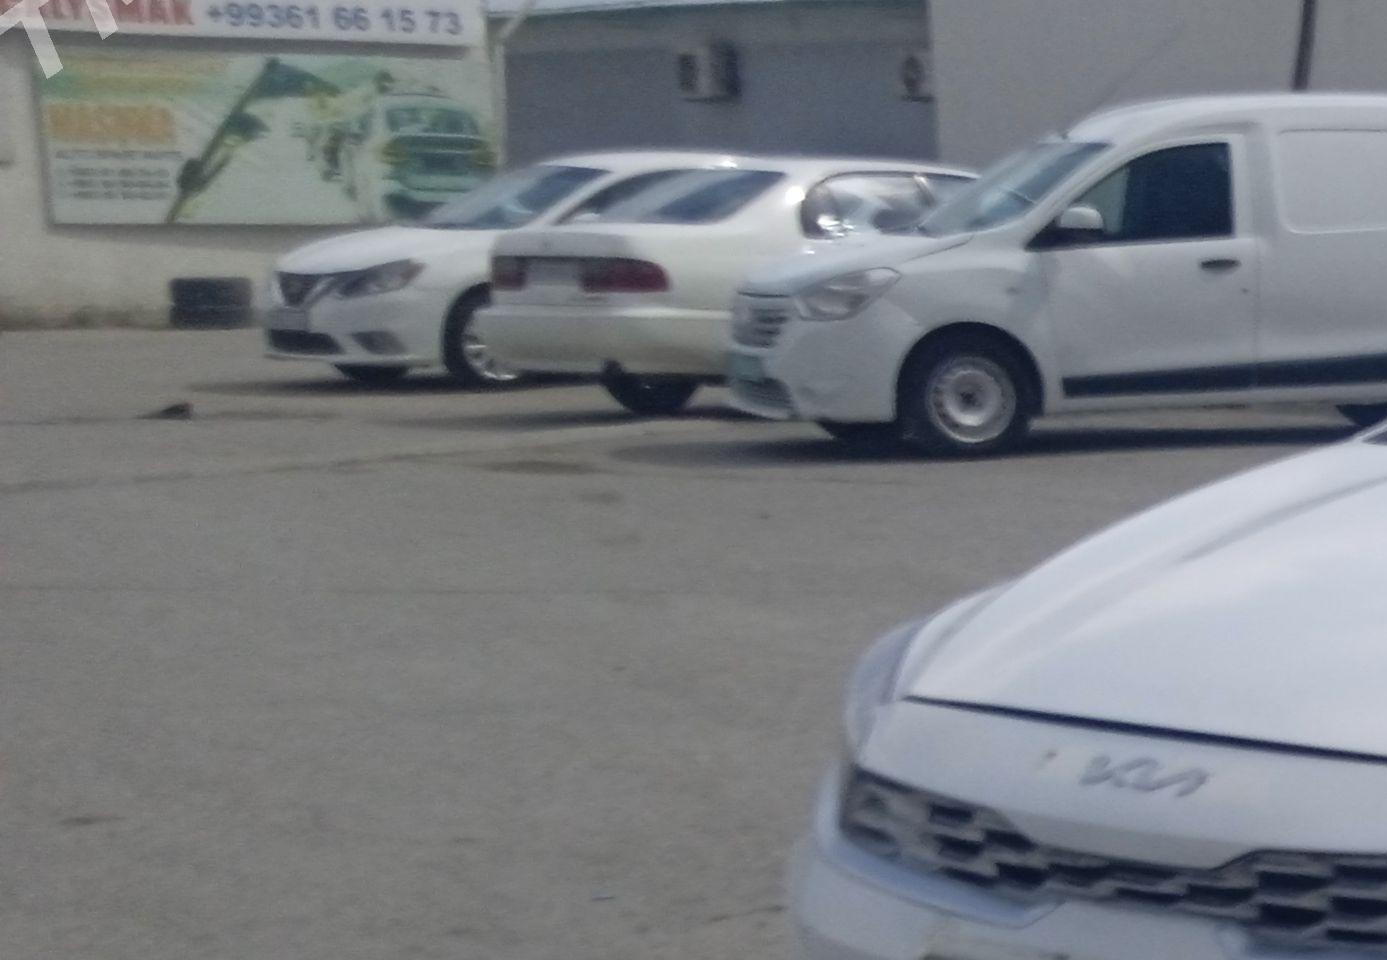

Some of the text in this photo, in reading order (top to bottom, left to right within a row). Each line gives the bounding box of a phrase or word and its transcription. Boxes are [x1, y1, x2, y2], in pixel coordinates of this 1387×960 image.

[207, 2, 320, 29] +99361
[333, 6, 370, 31] 66
[381, 9, 416, 34] 15
[424, 11, 463, 35] 73
